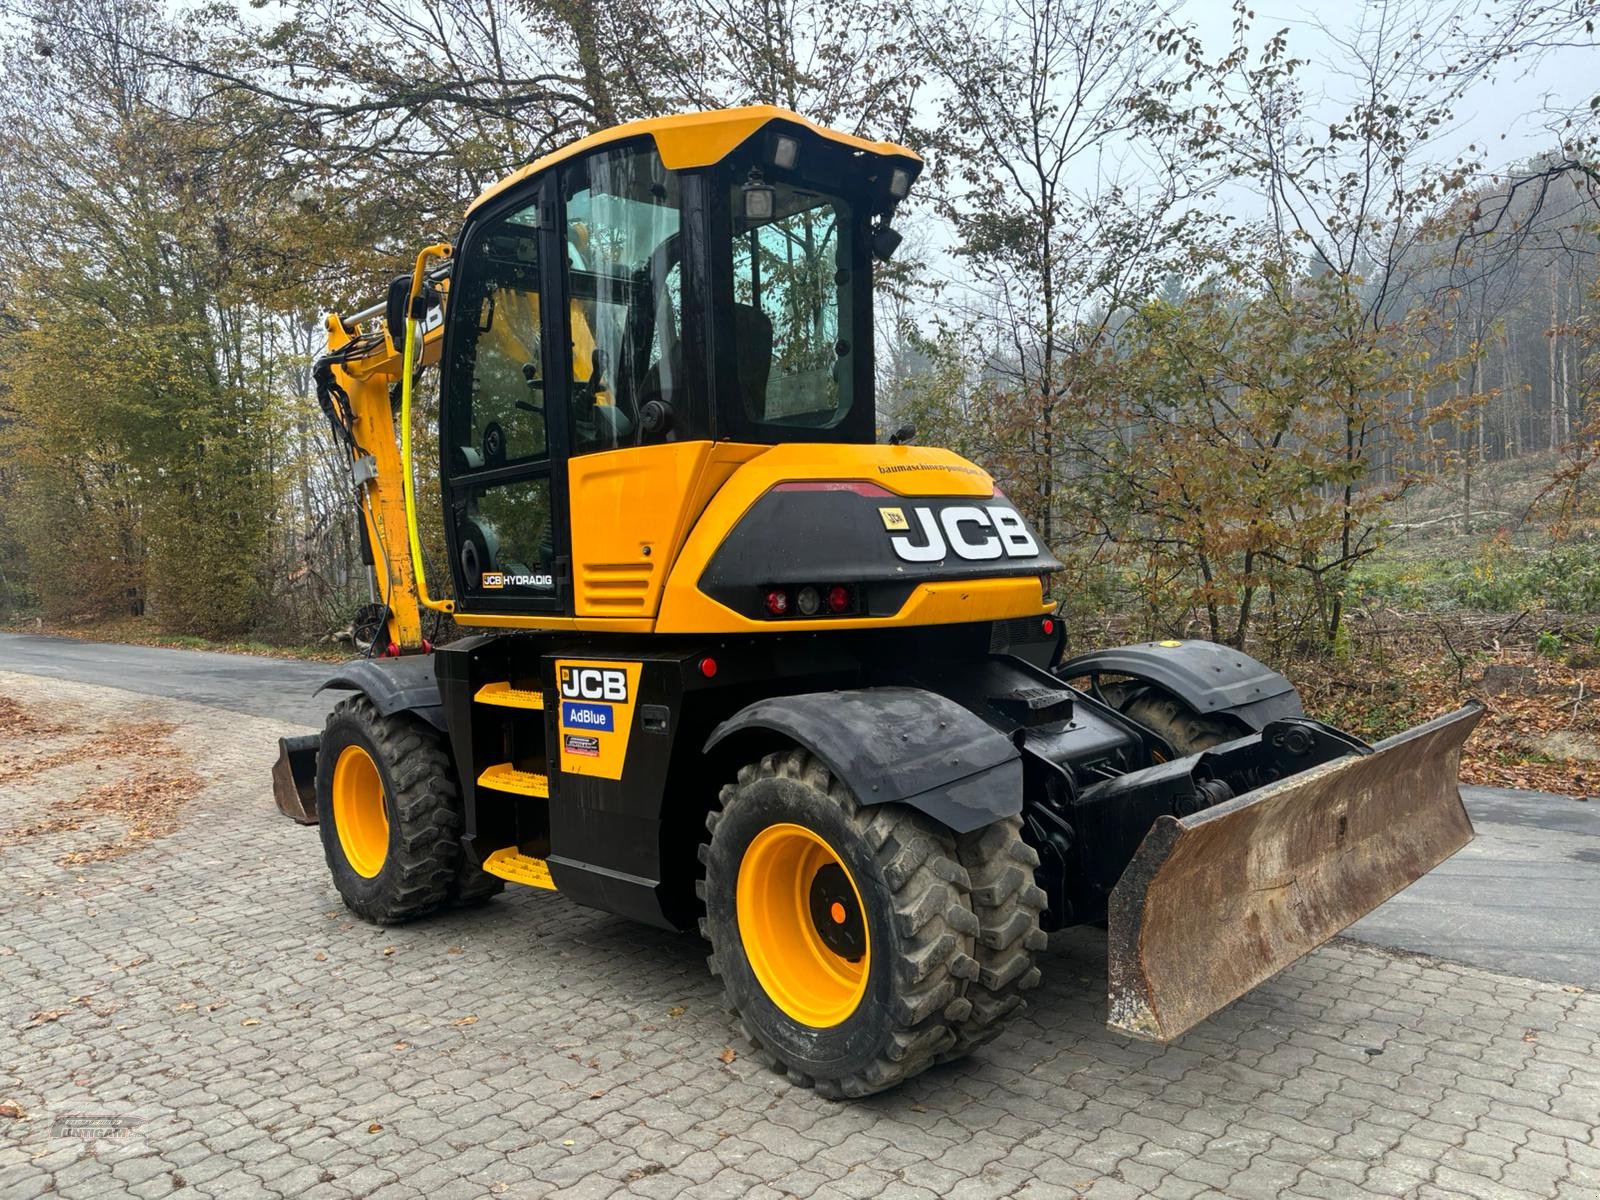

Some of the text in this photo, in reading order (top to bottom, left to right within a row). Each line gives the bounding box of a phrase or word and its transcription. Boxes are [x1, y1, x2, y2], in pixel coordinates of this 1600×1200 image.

[891, 507, 1039, 562] JCB
[484, 575, 552, 585] JCB HYDRADIG
[562, 669, 627, 701] JCB
[570, 709, 606, 725] AdBlue
